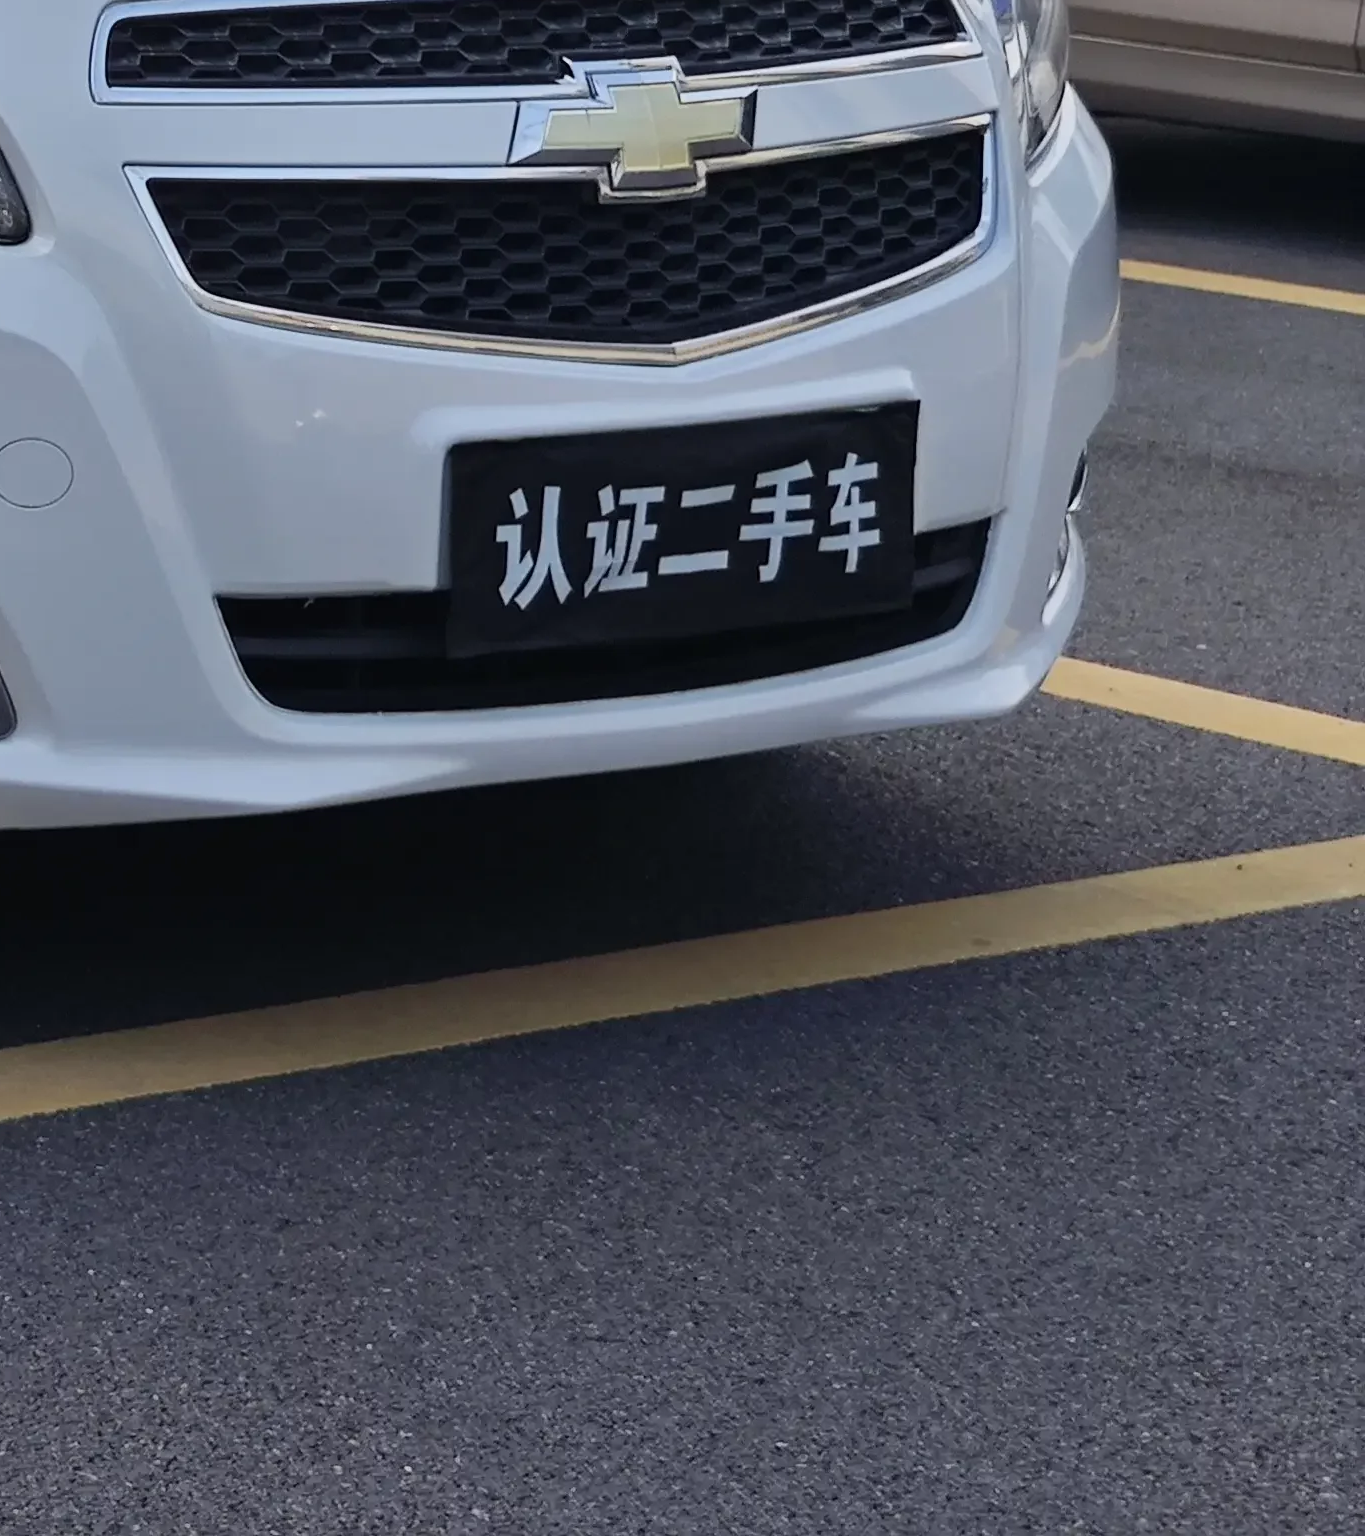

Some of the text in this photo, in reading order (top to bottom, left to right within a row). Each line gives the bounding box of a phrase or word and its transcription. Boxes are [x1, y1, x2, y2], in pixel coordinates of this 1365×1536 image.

[495, 452, 881, 610] 认证二手车
